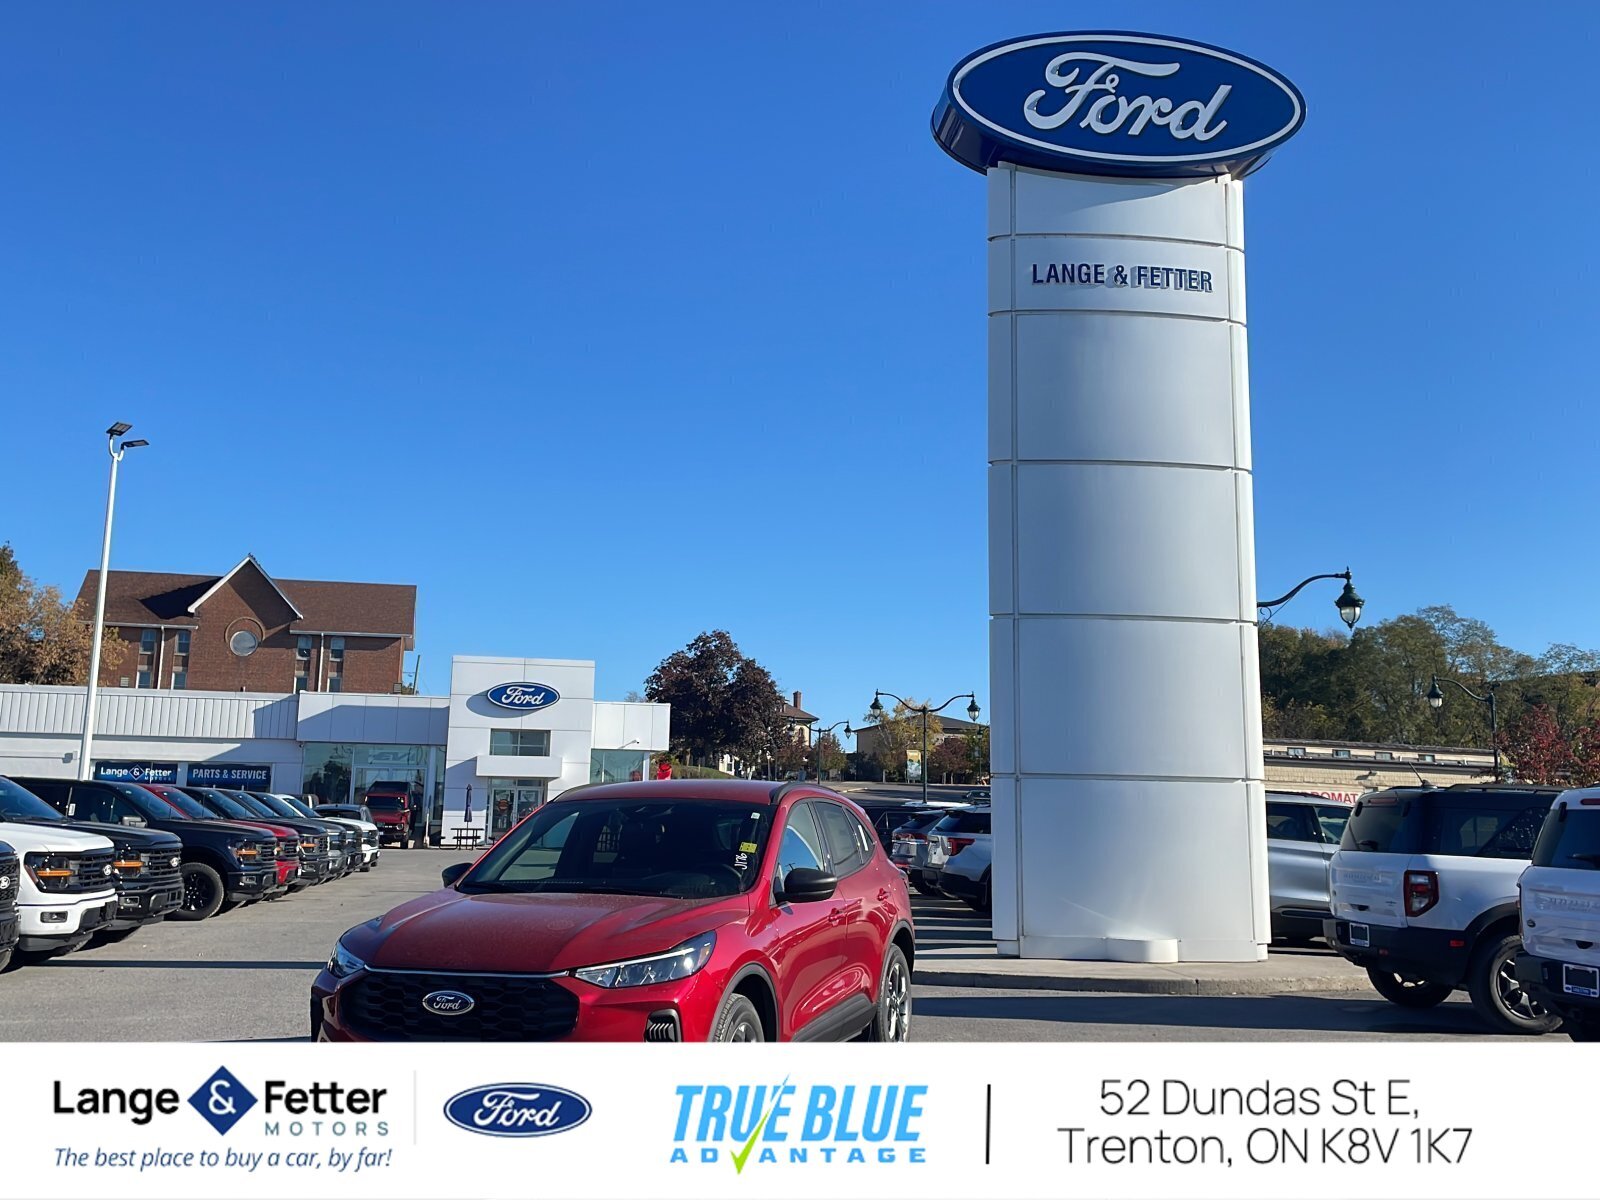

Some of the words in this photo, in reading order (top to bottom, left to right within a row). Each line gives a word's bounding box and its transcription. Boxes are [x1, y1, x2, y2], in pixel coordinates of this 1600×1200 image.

[1023, 51, 1232, 141] Ford
[1032, 263, 1105, 284] LANGE
[1113, 264, 1128, 285] &
[1136, 265, 1213, 291] FETTER
[501, 686, 546, 705] Ford
[100, 766, 128, 778] Lange
[144, 767, 172, 777] Fetter
[192, 768, 220, 779] PARTS
[222, 769, 229, 779] &
[231, 769, 267, 780] SERVICE
[433, 995, 462, 1010] Ford
